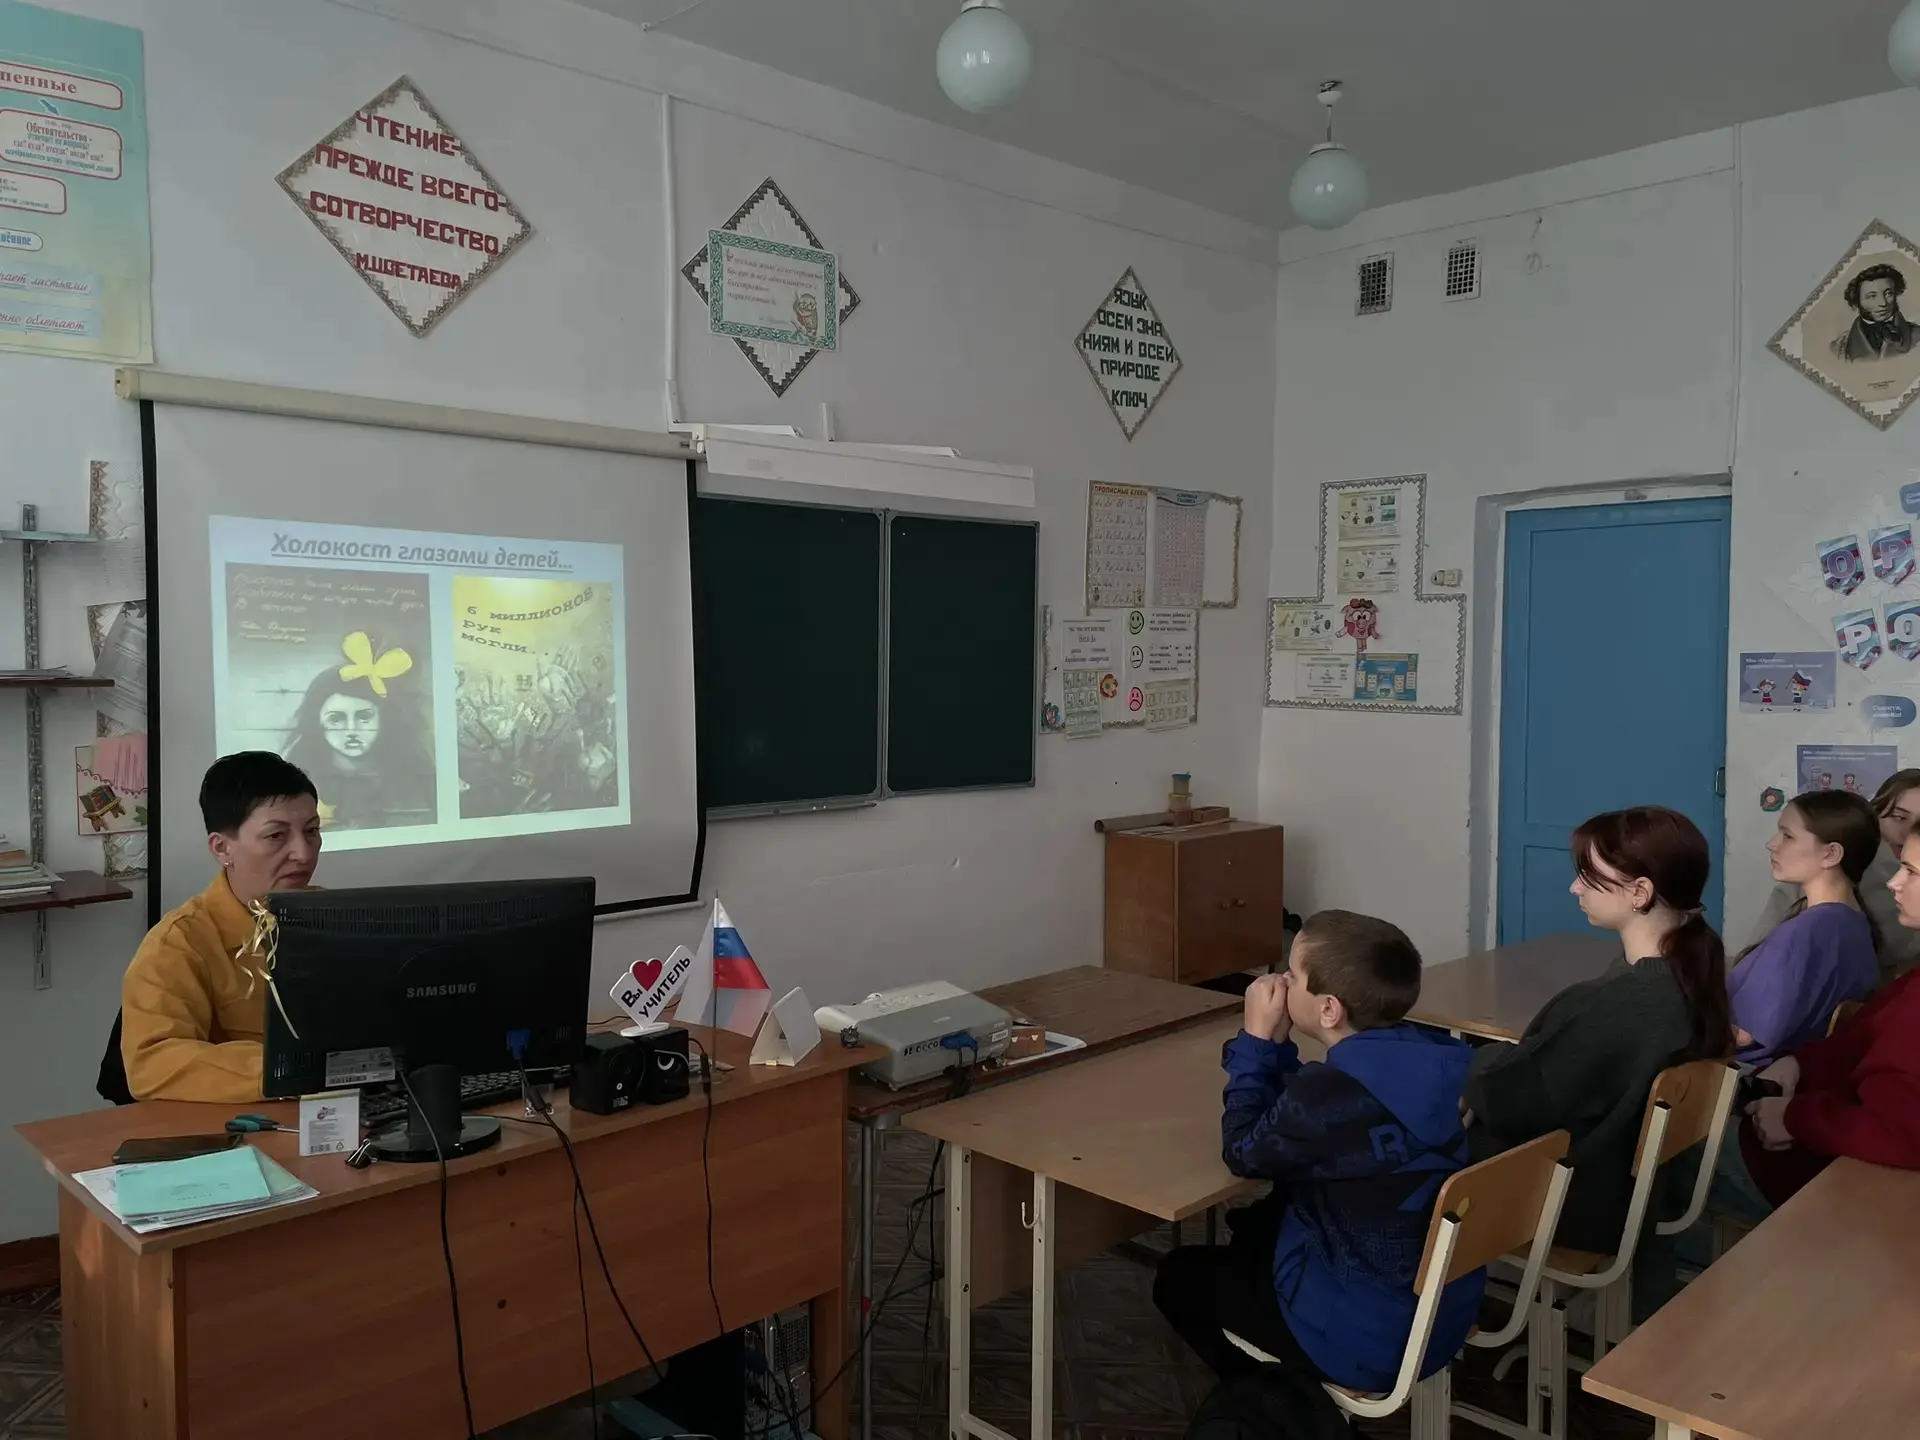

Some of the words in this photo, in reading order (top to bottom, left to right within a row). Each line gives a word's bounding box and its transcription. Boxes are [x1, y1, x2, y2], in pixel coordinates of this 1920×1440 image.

[26, 121, 88, 143] Обстоятельство
[314, 143, 414, 191] ПРЕЖДЕ
[310, 191, 499, 256] СОТВОРЧЕСТВО
[1113, 287, 1147, 311] ЯЗЫК
[1136, 317, 1163, 337] ЗНА
[1082, 333, 1120, 354] НИЯМ
[1125, 339, 1133, 355] И
[1100, 359, 1161, 381] ПРИРОДЕ
[1111, 389, 1148, 408] КЛЮЧ
[1094, 486, 1129, 495] ПРОПИСНЫЕ
[271, 532, 392, 559] Холокост
[398, 546, 488, 565] глазами
[494, 545, 573, 569] детей...
[489, 586, 594, 621] миллионов
[462, 619, 501, 635] рук
[406, 982, 477, 998] SAMSUNG
[621, 988, 643, 1008] Вы
[638, 957, 691, 1018] УЧИТЕЛЬ
